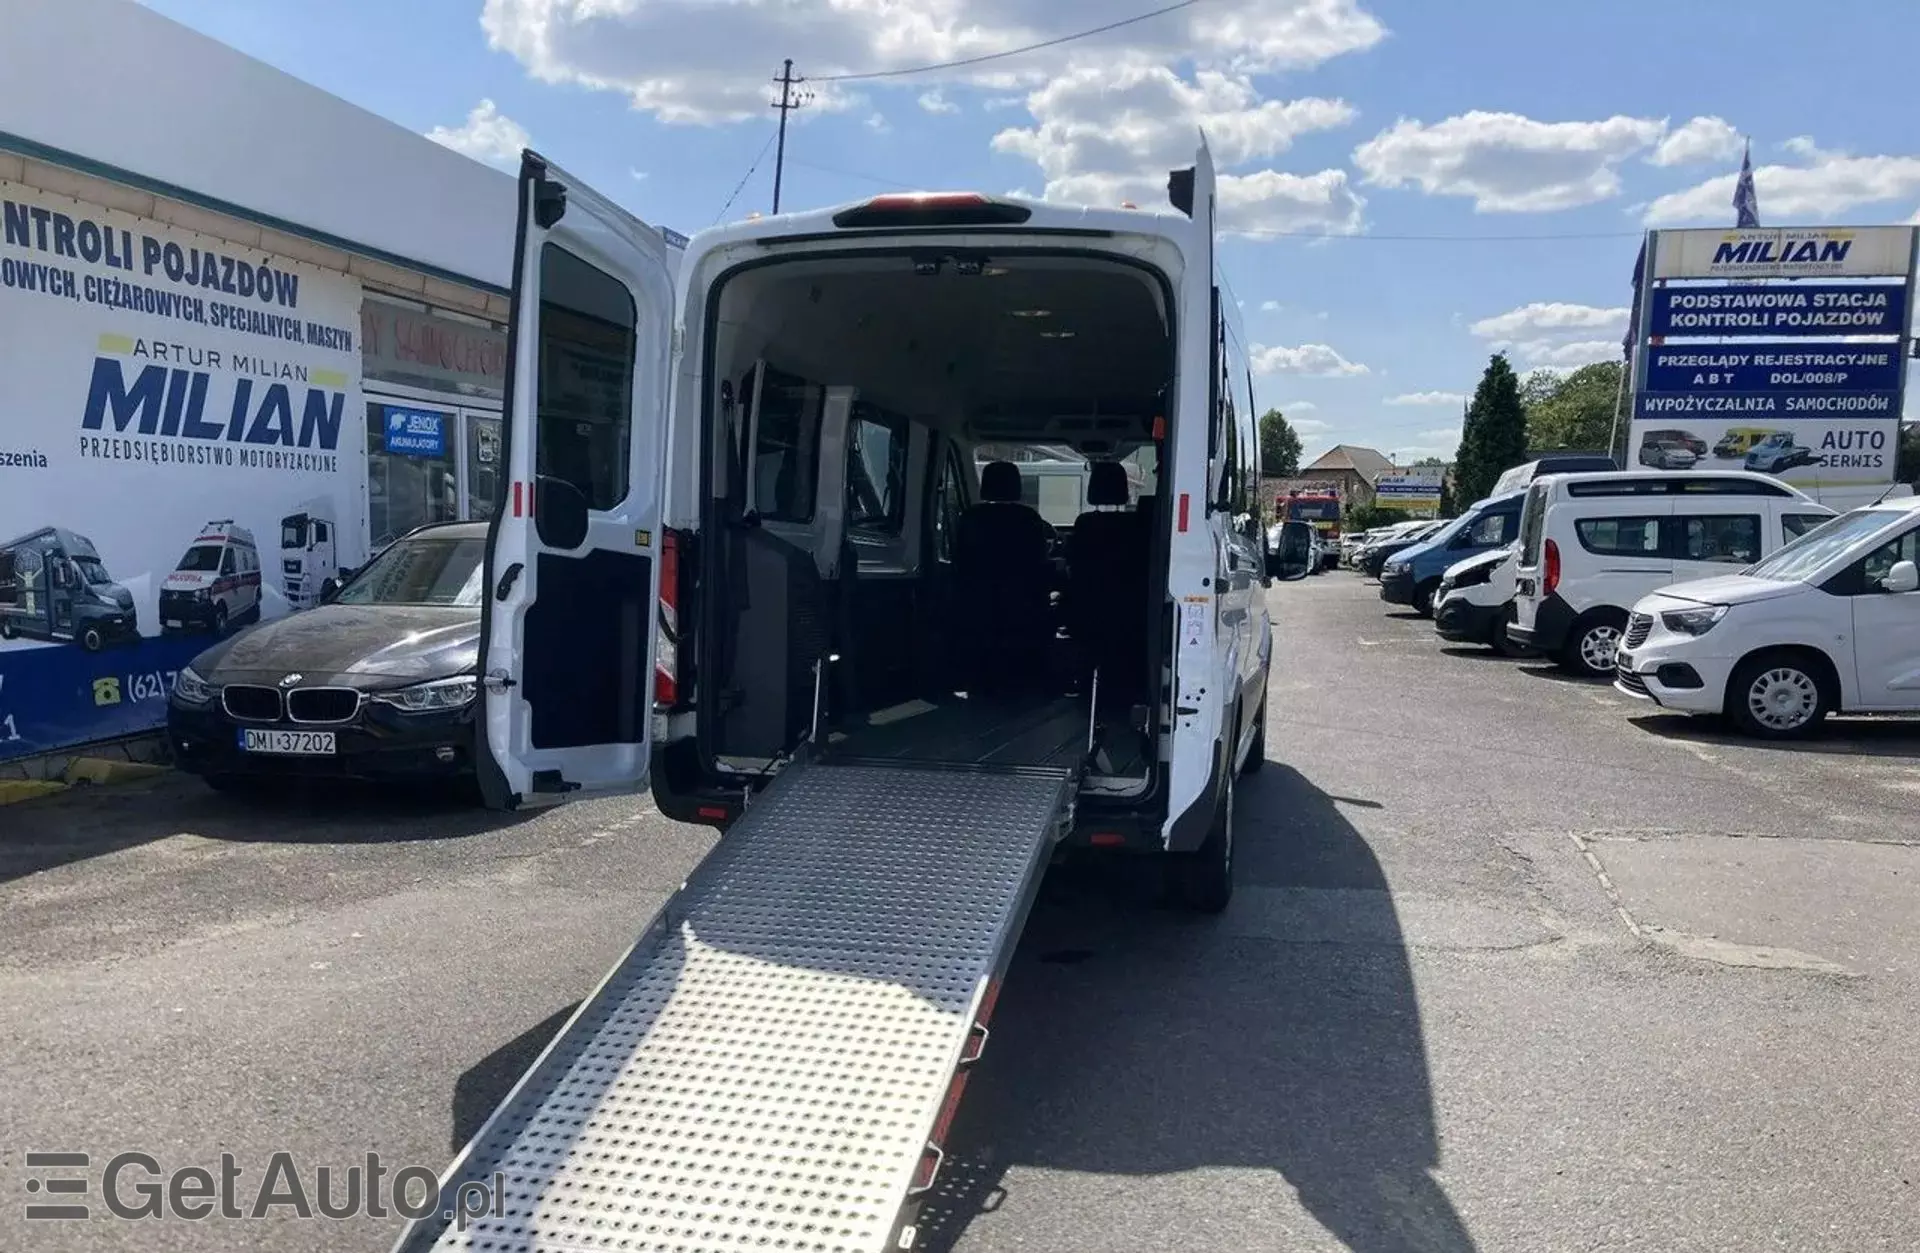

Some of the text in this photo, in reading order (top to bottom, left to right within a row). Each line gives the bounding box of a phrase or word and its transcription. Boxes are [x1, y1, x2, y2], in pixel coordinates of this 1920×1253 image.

[0, 200, 298, 308] NTROLI POJAZDÓW
[1712, 240, 1852, 264] MILIAN
[0, 257, 80, 302] OWYCH,
[84, 274, 207, 327] CIĘŻAROWYCH,
[210, 301, 305, 345] SPECJALNYCH,
[307, 322, 352, 352] MASZYN
[1669, 293, 1887, 309] PODSTAWOWA STACJA
[1670, 310, 1884, 327] KONTROLI POJAZDÓW
[133, 338, 309, 383] ARTUR MILIAN
[1657, 354, 1888, 368] PRZEGLĄDY REJESTRACYJNE
[1693, 373, 1704, 385] A
[1709, 374, 1719, 385] B
[1724, 374, 1735, 384] T
[81, 356, 346, 451] MILIAN
[1645, 394, 1889, 411] WYPOŻYCZALNIA SAMOCHODÓW
[1820, 431, 1885, 450] AUTO
[80, 436, 338, 473] PRZEDSIĘBIORSTWO MOTORYZACYJNE
[1819, 454, 1884, 469] SERWIS
[246, 731, 334, 752] DMI 37202
